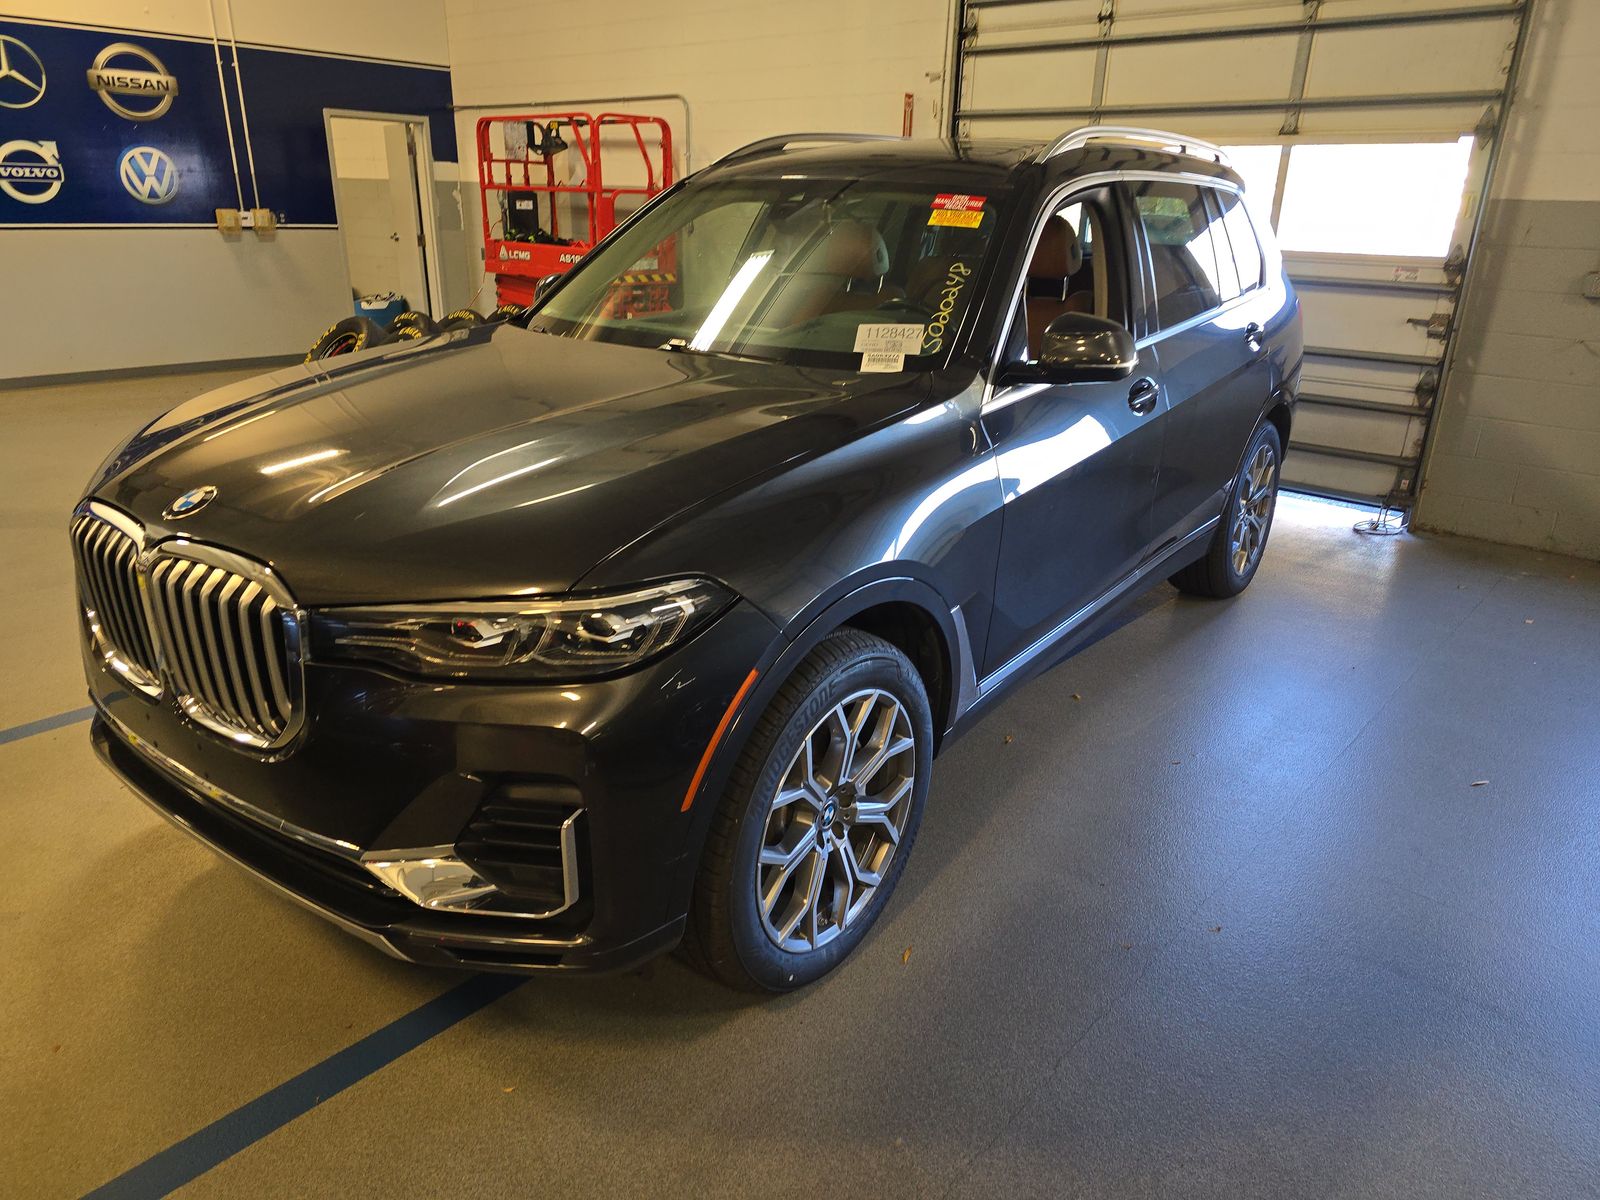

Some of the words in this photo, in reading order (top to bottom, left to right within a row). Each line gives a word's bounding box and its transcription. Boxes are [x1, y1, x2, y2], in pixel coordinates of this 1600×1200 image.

[97, 75, 169, 92] NISSAN
[0, 167, 59, 178] VOLVO
[866, 328, 923, 339] 1128427
